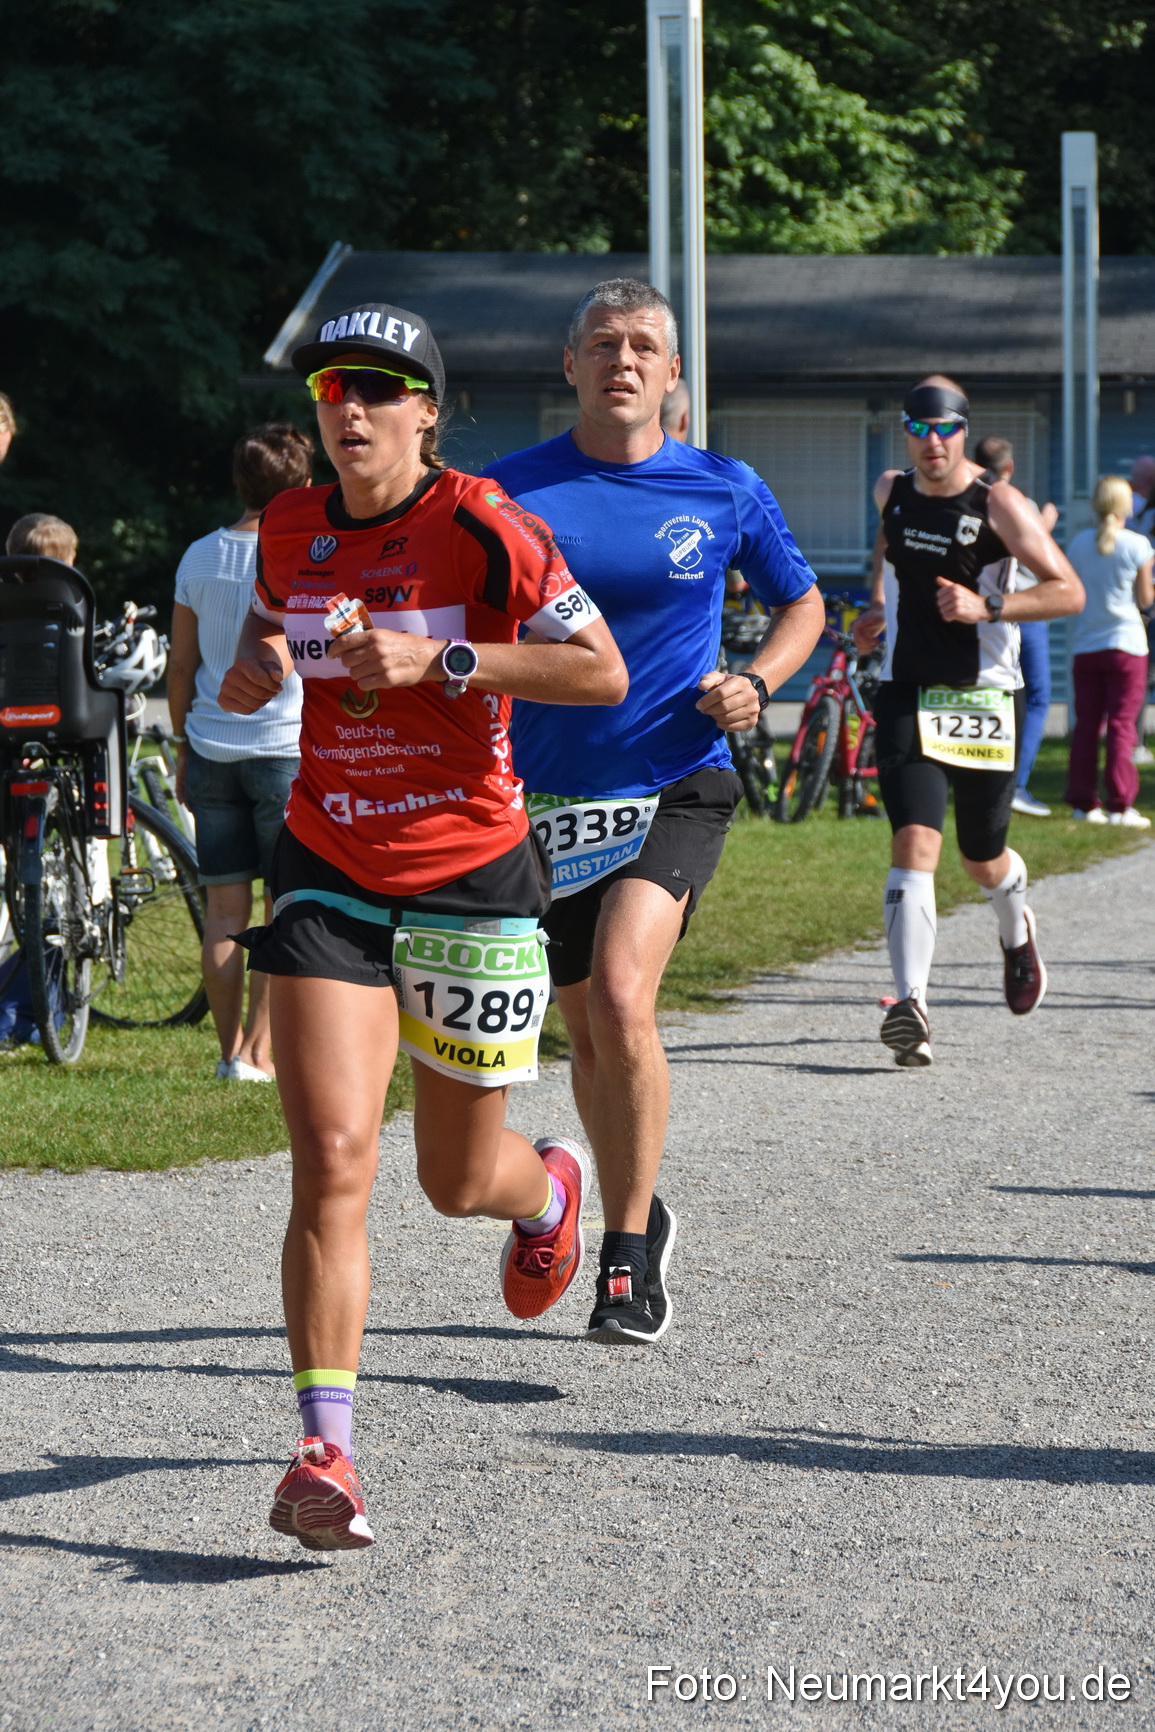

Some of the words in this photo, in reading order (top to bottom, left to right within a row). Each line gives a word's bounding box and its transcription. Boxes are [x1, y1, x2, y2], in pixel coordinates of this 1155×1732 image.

[320, 312, 420, 352] OAKLEY
[654, 514, 690, 539] Sportverein
[691, 515, 716, 540] Lupburg
[918, 530, 952, 544] Marathon
[904, 538, 948, 556] Regensburg
[298, 569, 335, 578] Volkswagen
[360, 564, 403, 579] SCHLENK
[668, 571, 705, 580] Lauftreff
[335, 724, 395, 740] Deutsche
[931, 715, 1003, 740] 1232
[312, 741, 441, 763] Vermögensberatung
[931, 742, 1004, 759] JOHANNES
[345, 768, 373, 777] Oliver
[374, 764, 405, 775] Krauß
[356, 787, 468, 816] Einhell
[536, 806, 640, 856] 2338
[551, 843, 635, 884] HRISTIAN
[411, 935, 537, 972] BOCK
[413, 981, 535, 1034] 1289
[538, 989, 544, 998] A
[433, 1037, 506, 1068] VIOLA
